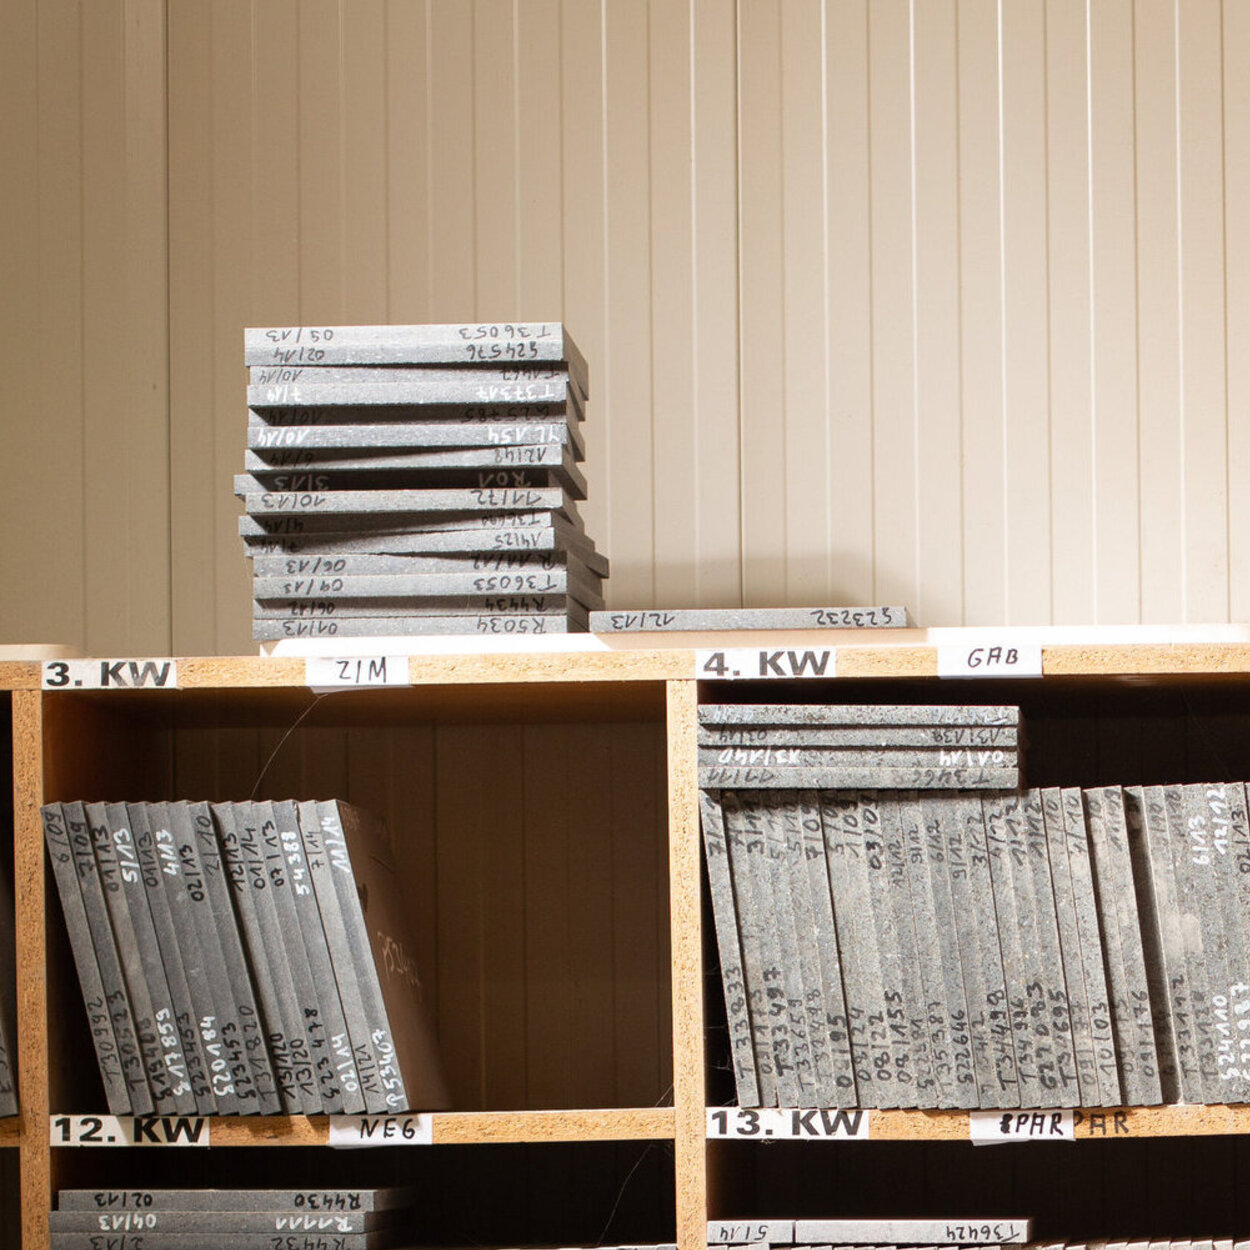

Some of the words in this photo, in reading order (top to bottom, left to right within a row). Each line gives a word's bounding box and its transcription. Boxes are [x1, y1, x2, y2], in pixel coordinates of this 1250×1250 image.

[703, 652, 741, 676] 4.
[759, 651, 831, 676] KW
[967, 646, 1019, 668] GAB
[46, 662, 83, 686] 3.
[101, 662, 171, 686] KW
[336, 657, 387, 684] ZIM
[55, 1118, 116, 1142] 12.
[134, 1117, 205, 1142] KW
[360, 1118, 416, 1139] NEG
[710, 1111, 773, 1136] 13.
[791, 1111, 864, 1136] KW
[1015, 1112, 1063, 1135] PAR
